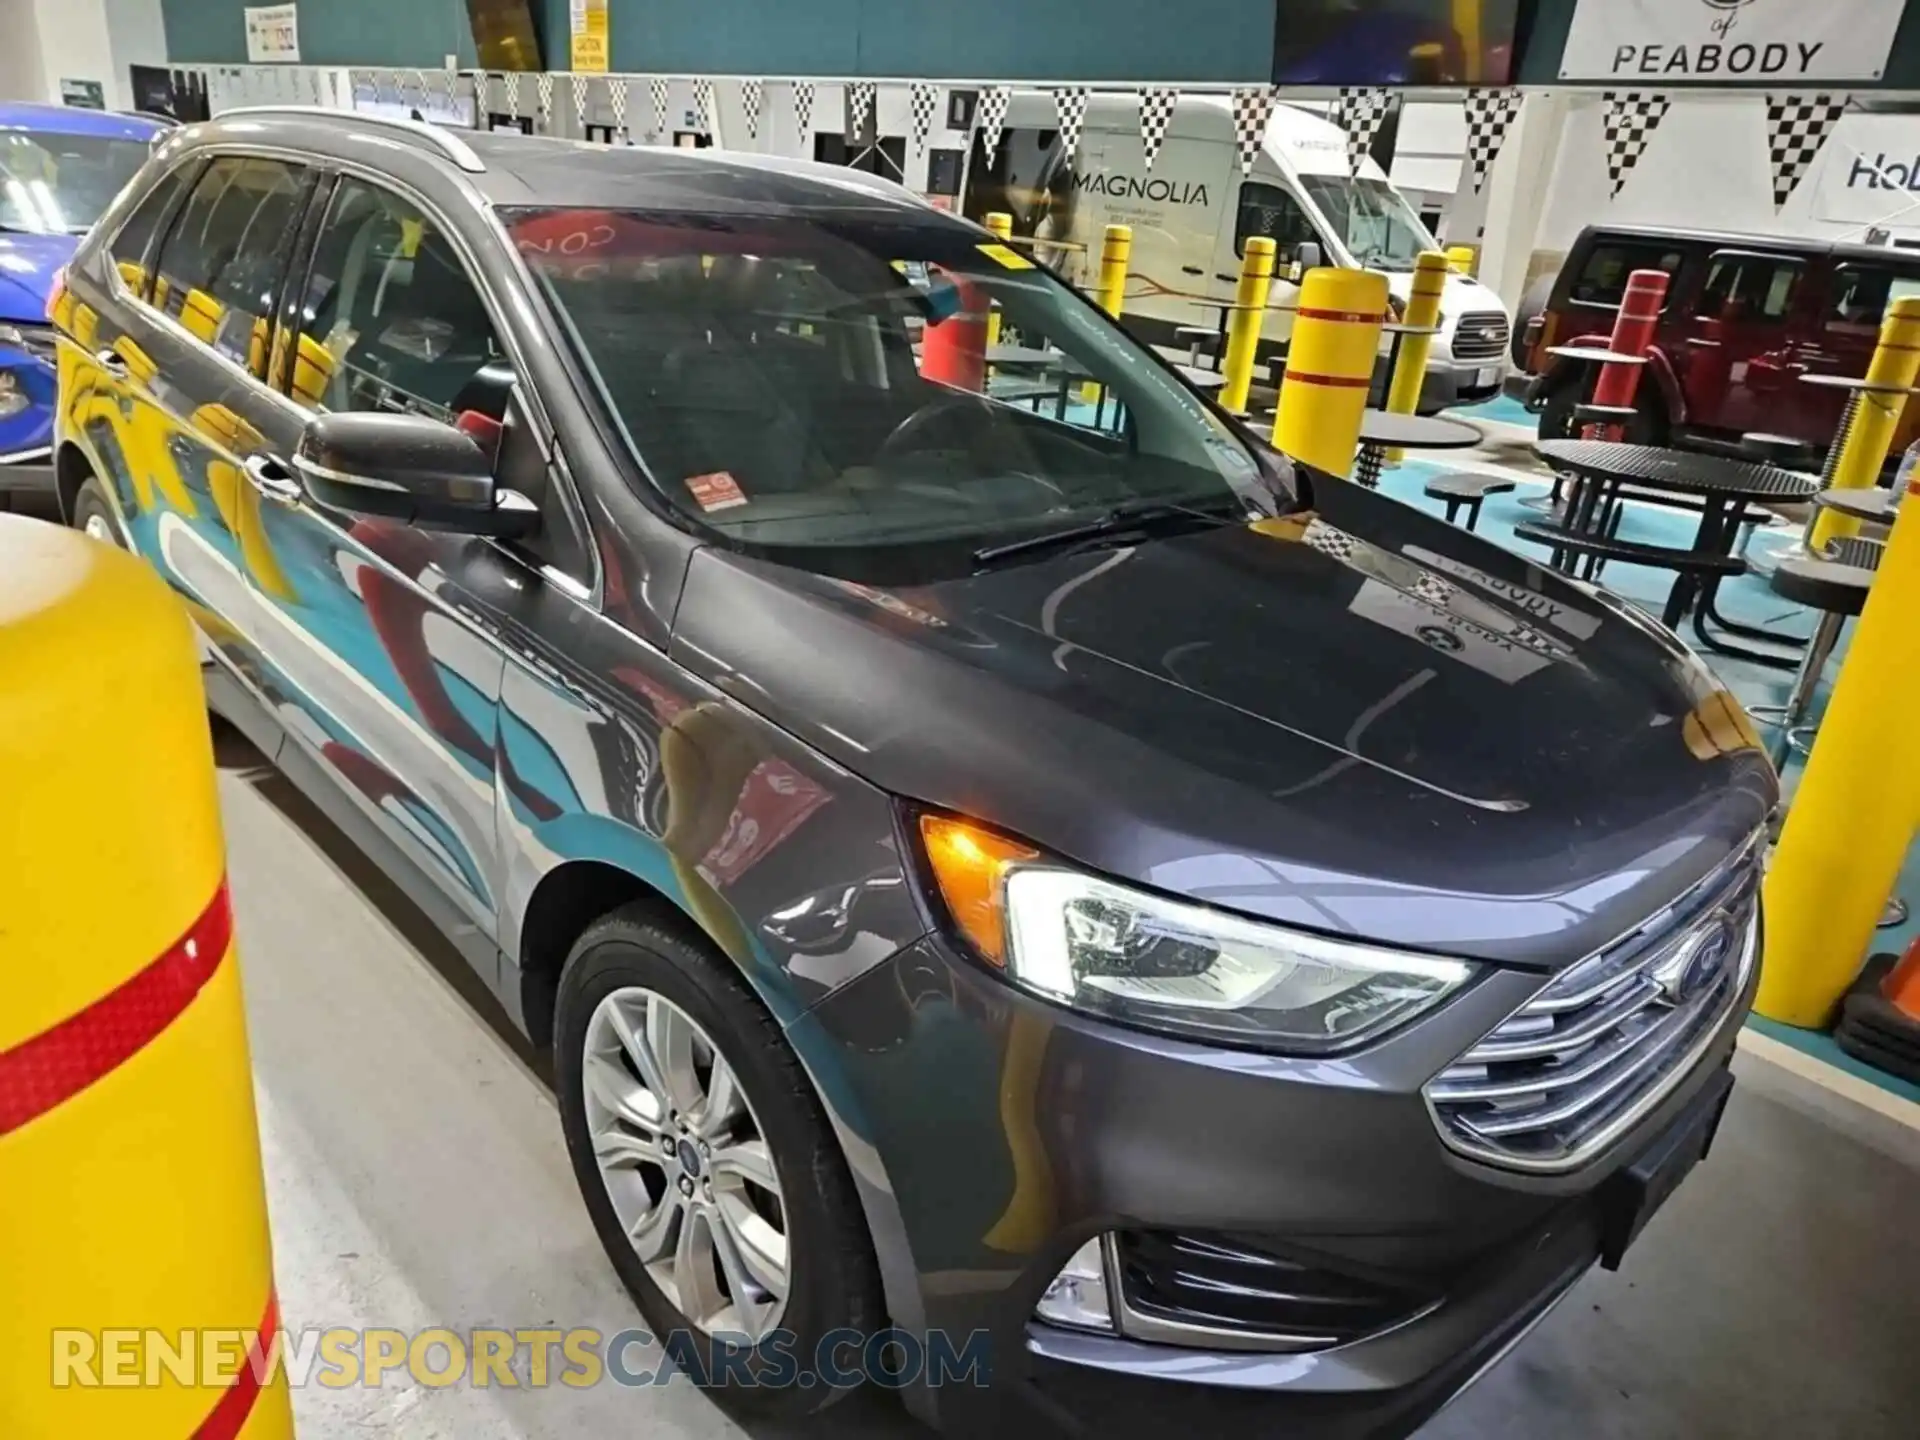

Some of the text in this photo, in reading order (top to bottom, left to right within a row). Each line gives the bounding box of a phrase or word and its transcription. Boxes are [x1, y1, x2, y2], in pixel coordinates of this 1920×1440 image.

[1710, 11, 1738, 40] of
[1612, 42, 1824, 74] PEABODY
[1071, 171, 1209, 207] MAGNOLIA
